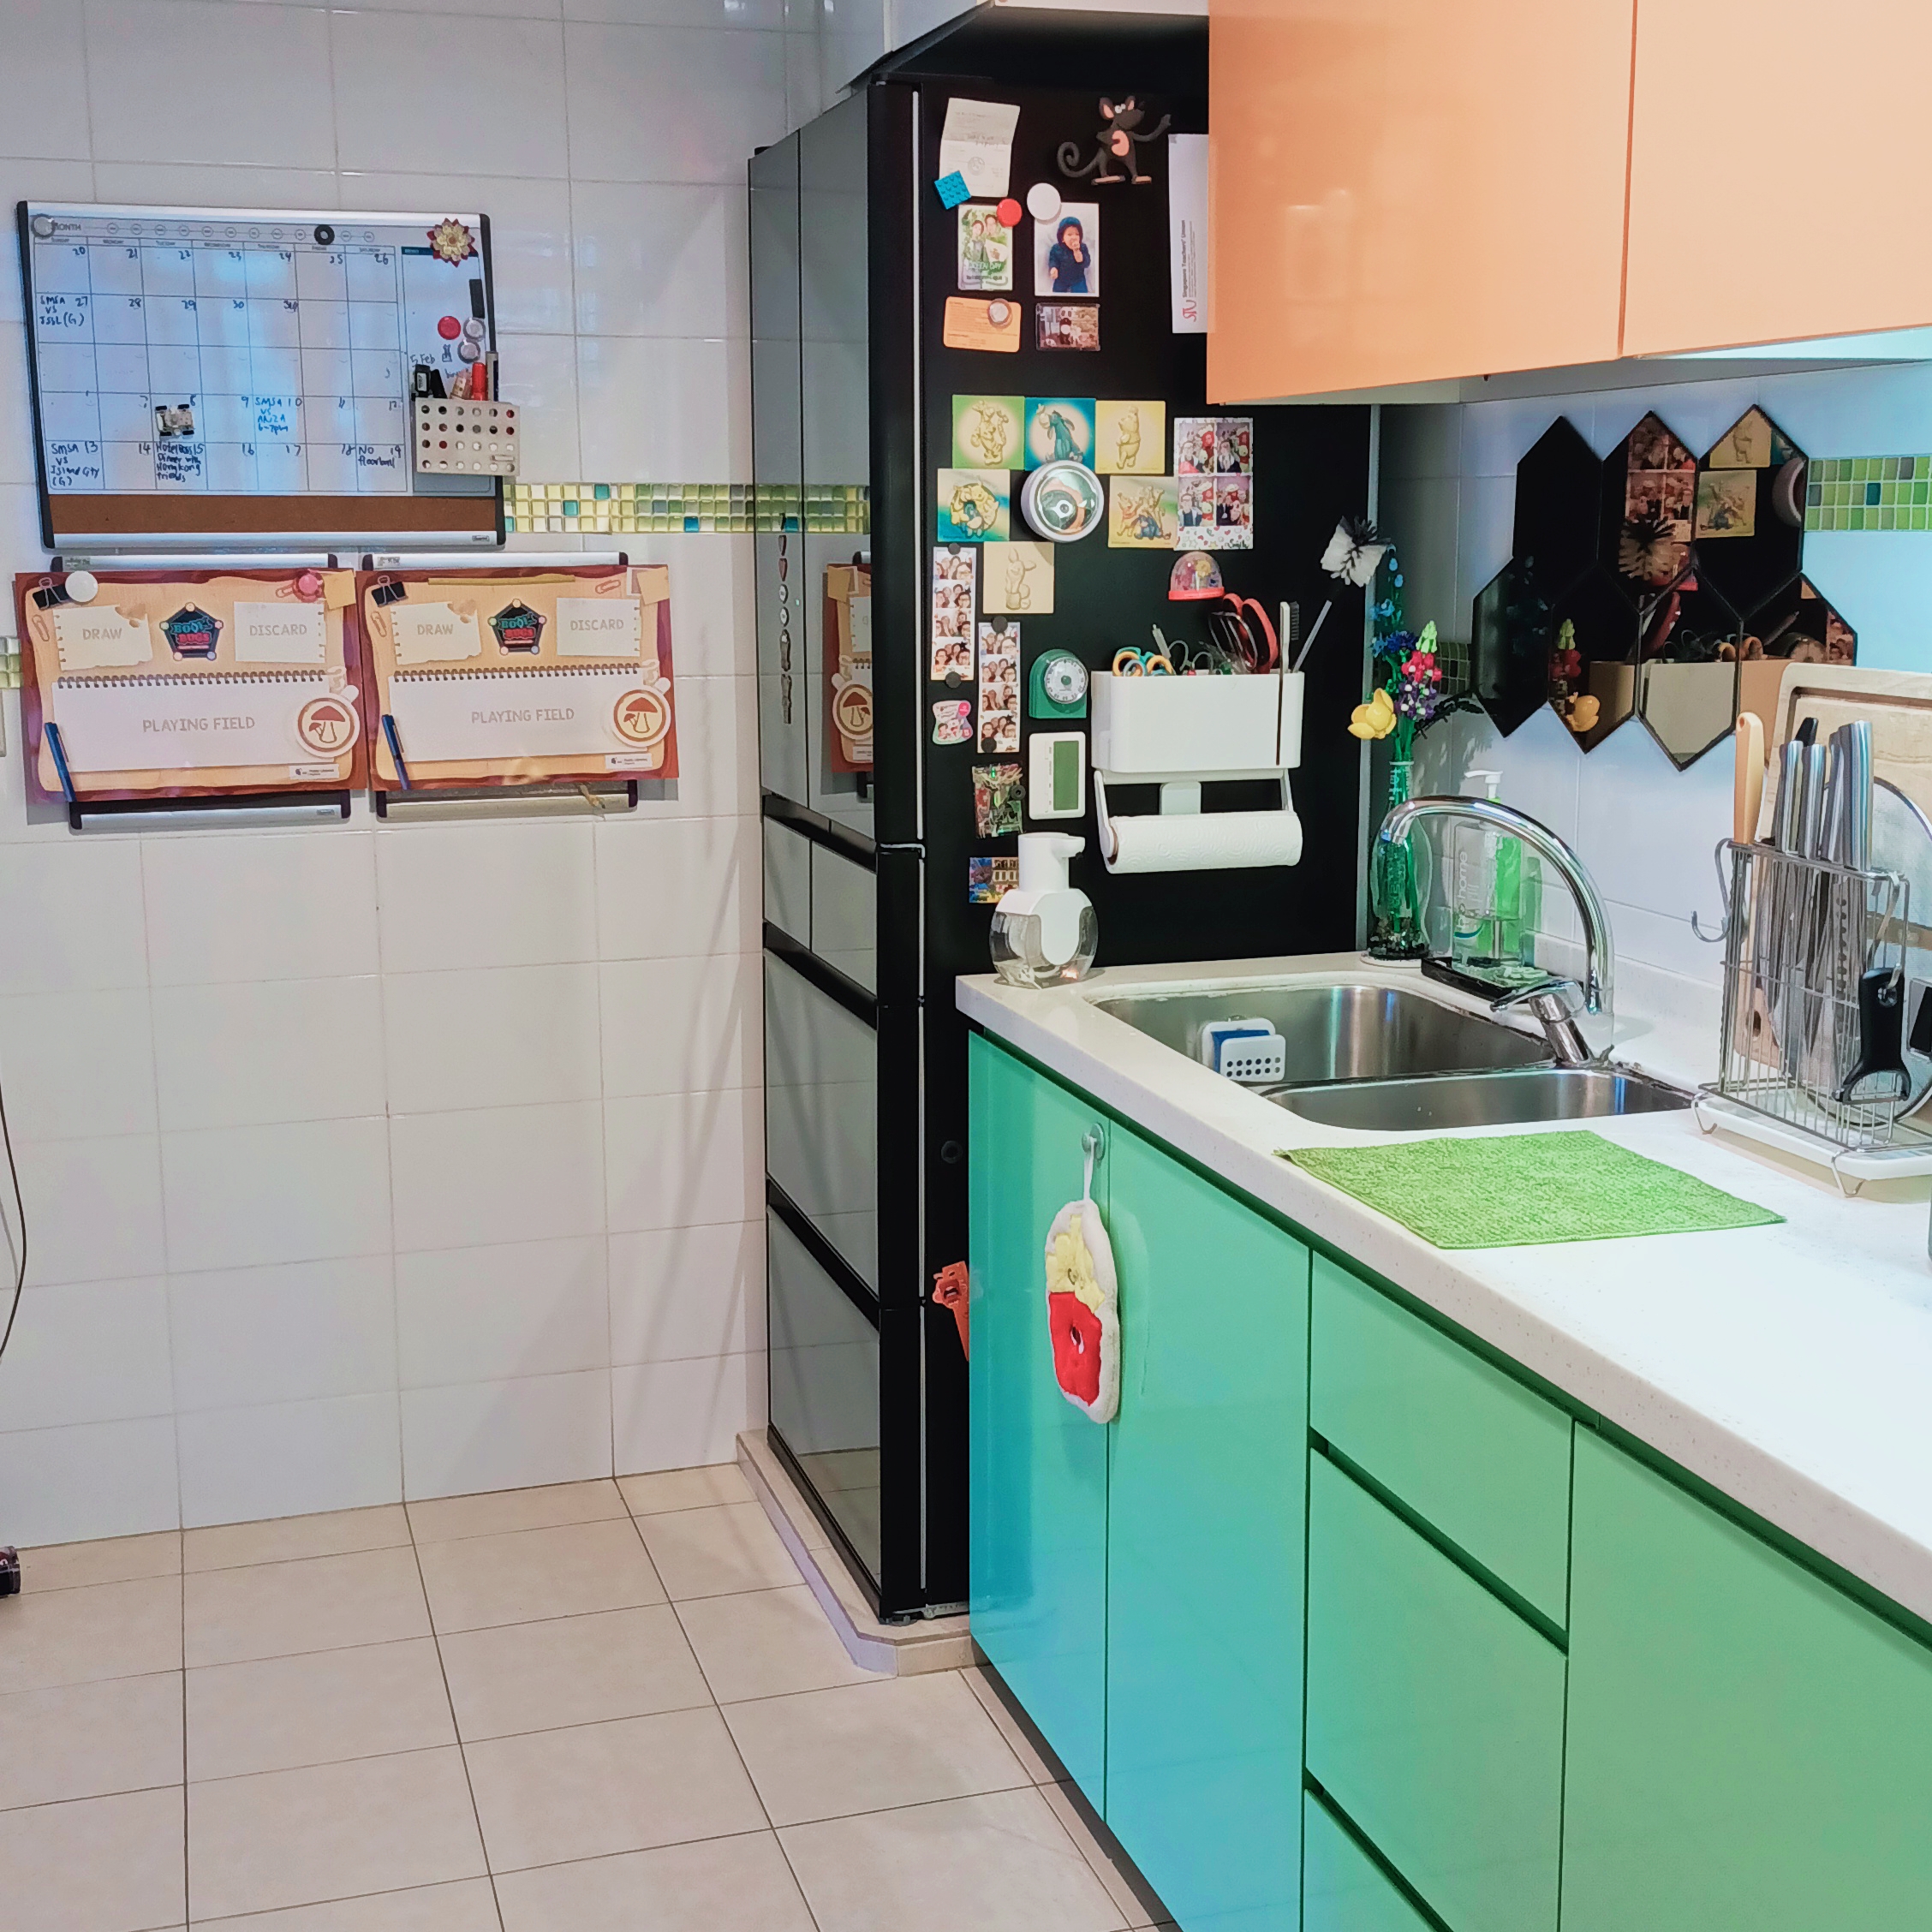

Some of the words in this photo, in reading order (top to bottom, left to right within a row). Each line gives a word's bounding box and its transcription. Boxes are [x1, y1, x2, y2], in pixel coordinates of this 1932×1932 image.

[72, 247, 86, 256] 20
[126, 248, 138, 259] 21
[279, 253, 292, 262] 24
[374, 253, 389, 265] 26
[75, 295, 88, 307] 27
[128, 298, 142, 308] 28
[182, 300, 196, 311] 29
[232, 300, 245, 309] 30
[241, 397, 249, 408] 9
[288, 397, 303, 407] 10
[85, 441, 98, 454] 13
[139, 442, 151, 455] 14
[242, 443, 255, 456] 16
[285, 444, 301, 456] 17
[390, 445, 401, 458] 19
[249, 623, 307, 636] DISCARD
[417, 623, 453, 635] DRAW
[569, 618, 624, 630] DISCARD
[82, 628, 122, 641] DRAW
[471, 710, 531, 724] PLAYING
[536, 708, 575, 721] FIELD
[142, 718, 208, 732] PLAYING
[213, 716, 255, 730] FIELD
